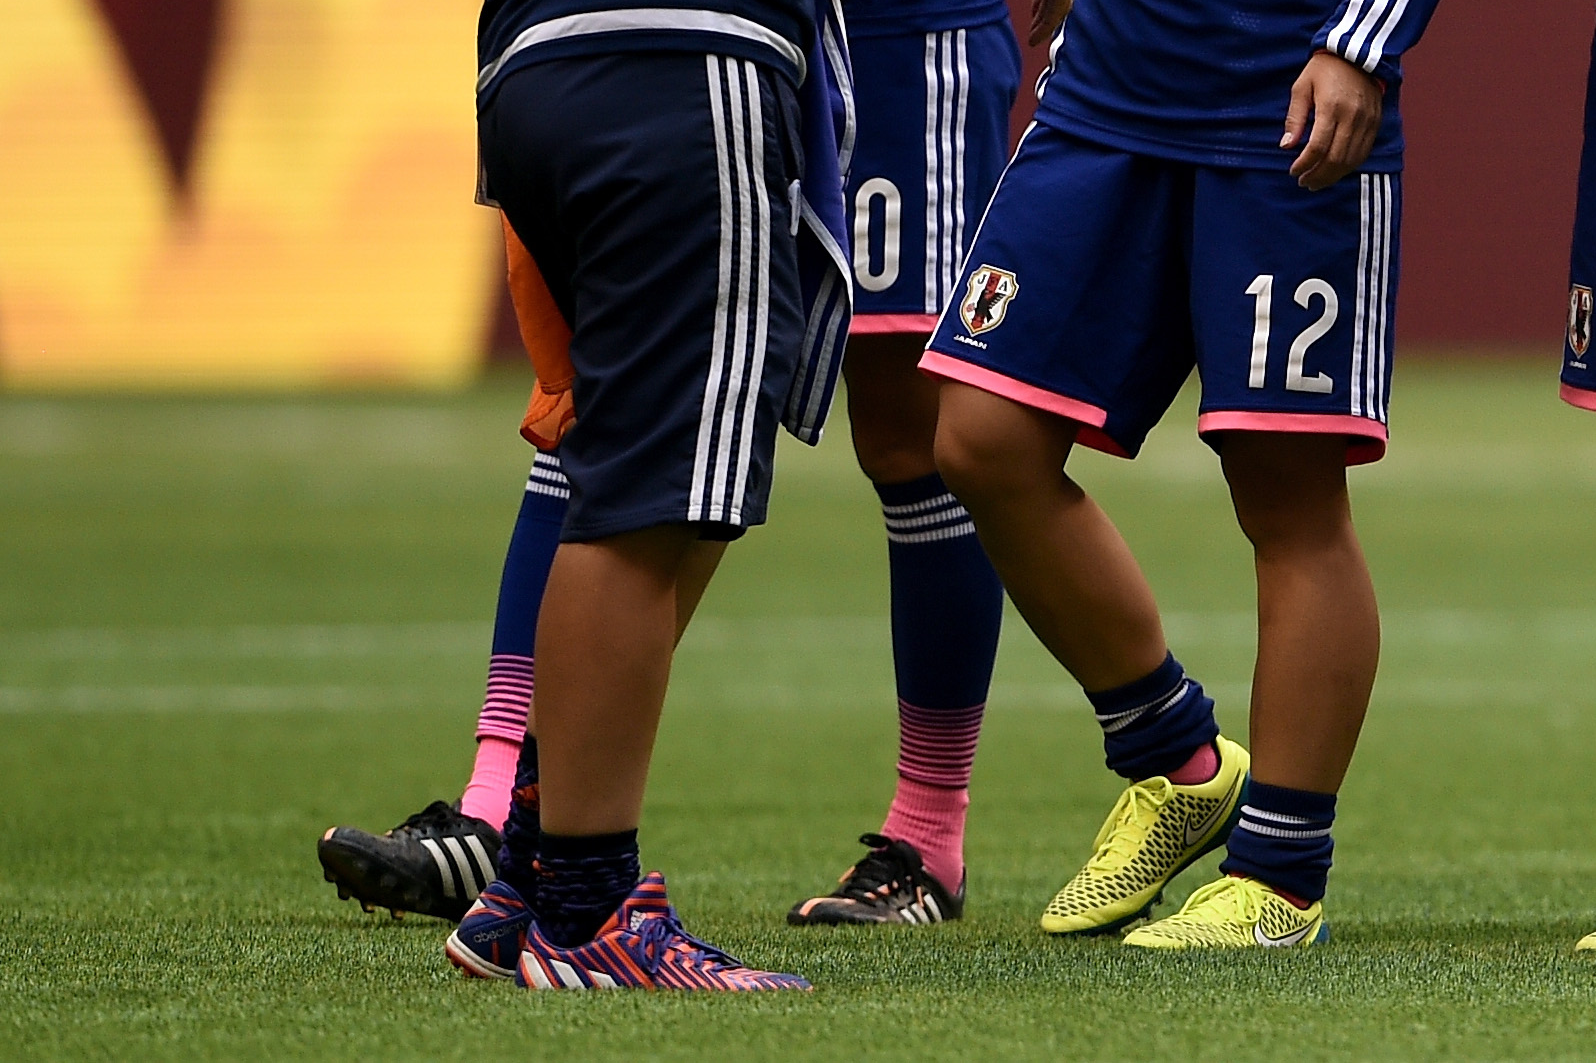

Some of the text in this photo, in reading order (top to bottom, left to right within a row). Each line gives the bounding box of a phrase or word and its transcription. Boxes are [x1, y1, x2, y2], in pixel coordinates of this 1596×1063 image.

[841, 176, 901, 292] 0
[953, 334, 987, 350] JAPAN
[1244, 275, 1339, 393] 12
